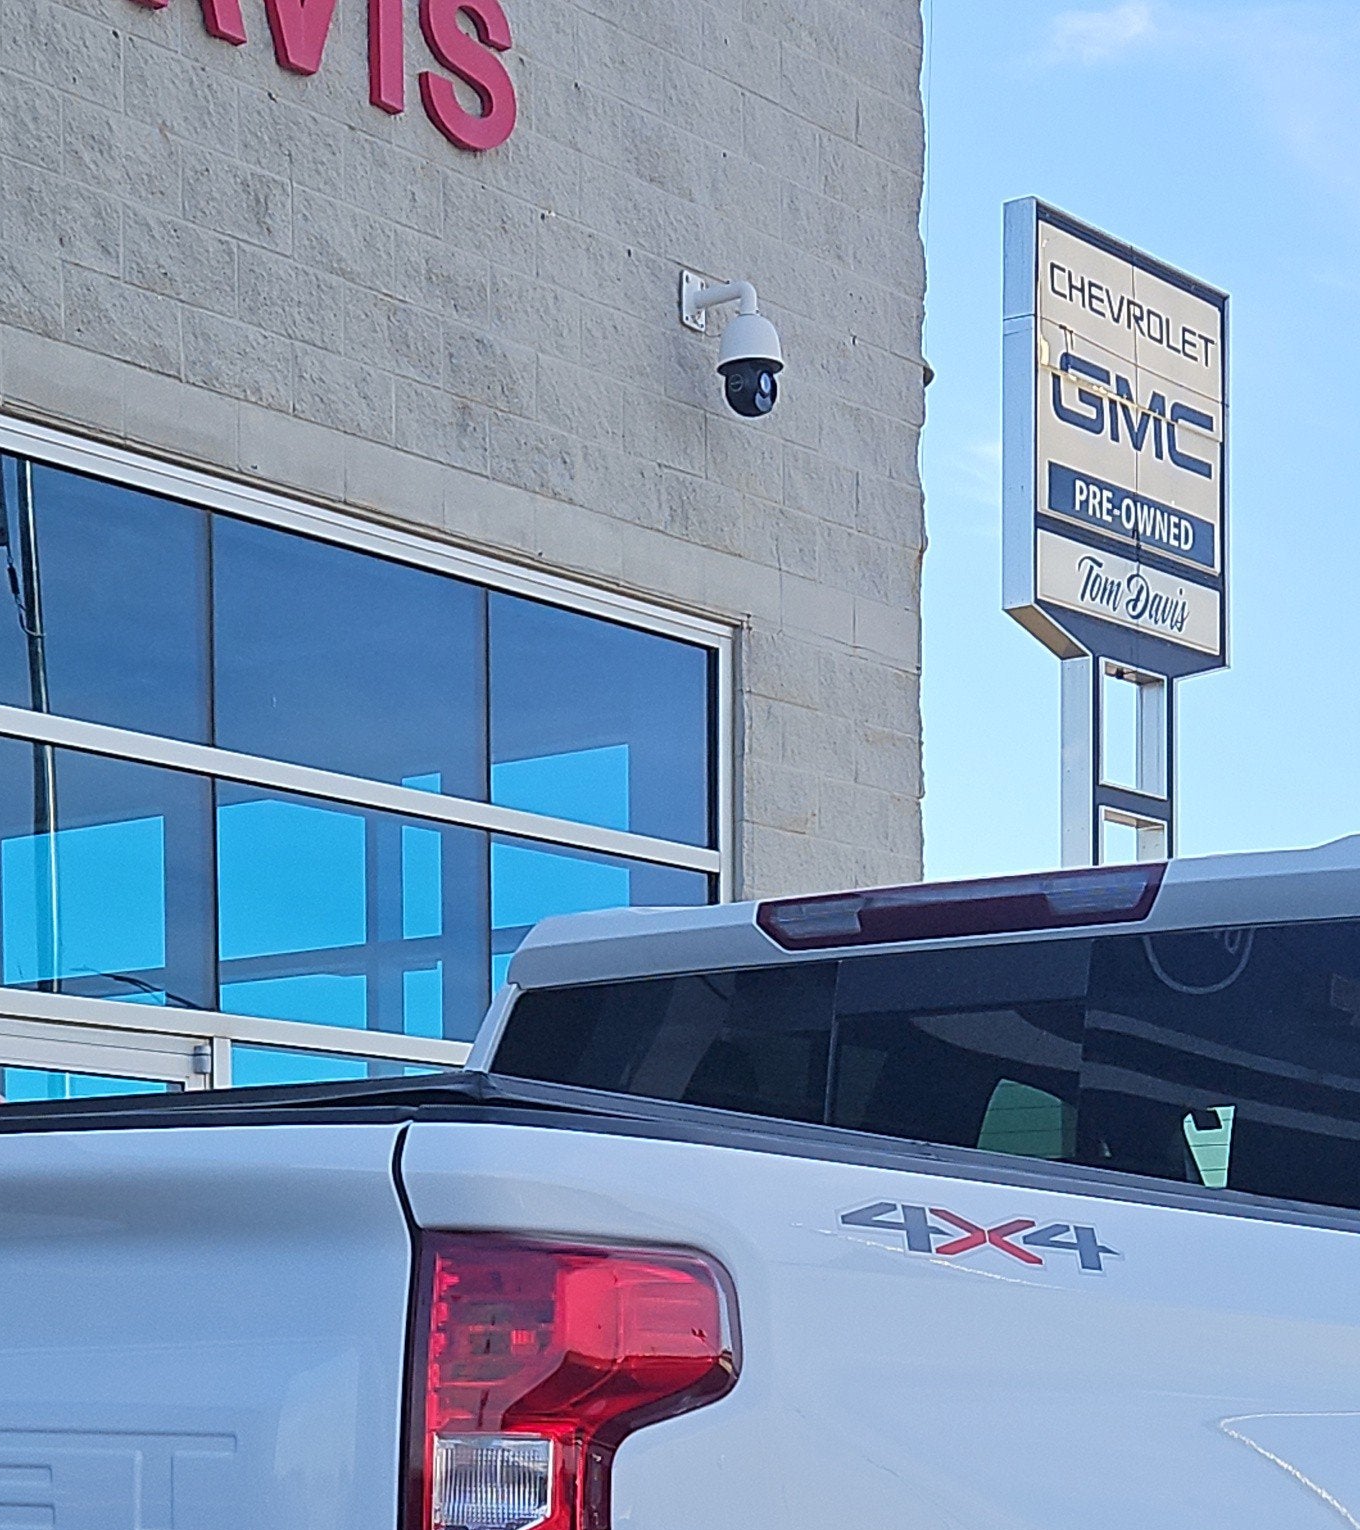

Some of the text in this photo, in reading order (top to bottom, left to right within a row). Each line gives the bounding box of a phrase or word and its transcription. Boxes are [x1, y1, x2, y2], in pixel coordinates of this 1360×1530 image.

[1049, 261, 1216, 368] CHEVROLET
[1051, 351, 1215, 480] GMC
[1074, 478, 1194, 551] PRE-OWNED
[1077, 555, 1190, 632] Tom Davis
